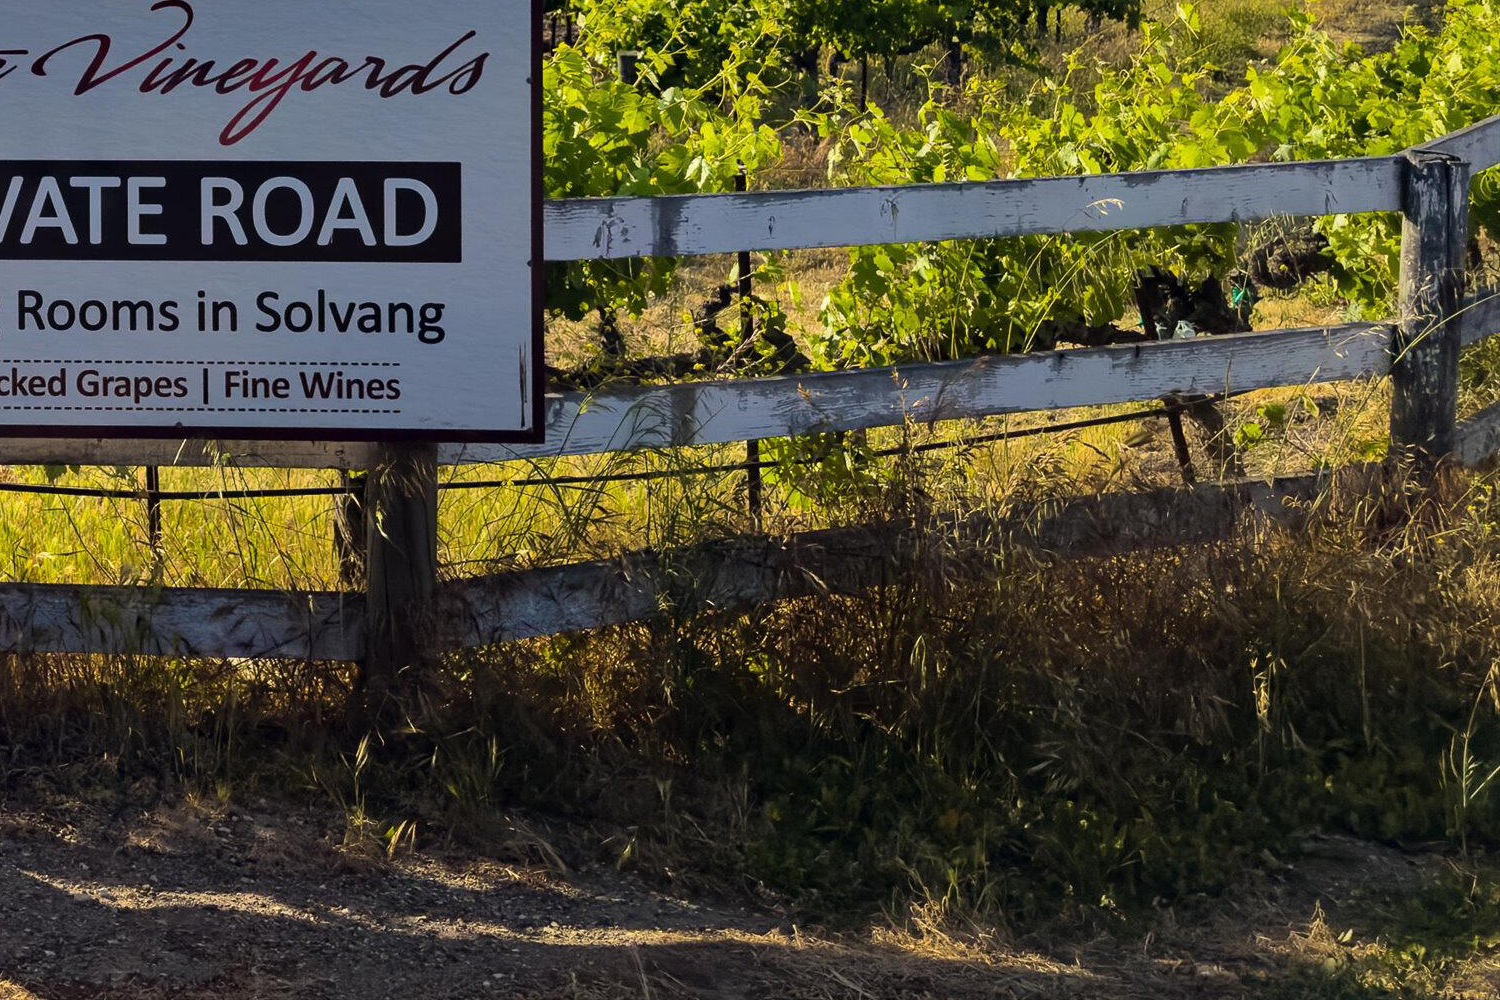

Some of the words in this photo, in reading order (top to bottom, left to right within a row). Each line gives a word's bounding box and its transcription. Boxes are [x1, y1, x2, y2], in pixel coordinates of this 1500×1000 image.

[31, 0, 491, 146] Vineyards
[200, 176, 438, 247] ROAD
[16, 290, 180, 333] Rooms
[197, 290, 238, 333] in
[255, 289, 446, 345] Solvang
[76, 371, 188, 404] Grapes
[224, 369, 291, 398] Fine
[300, 370, 401, 400] Wines
